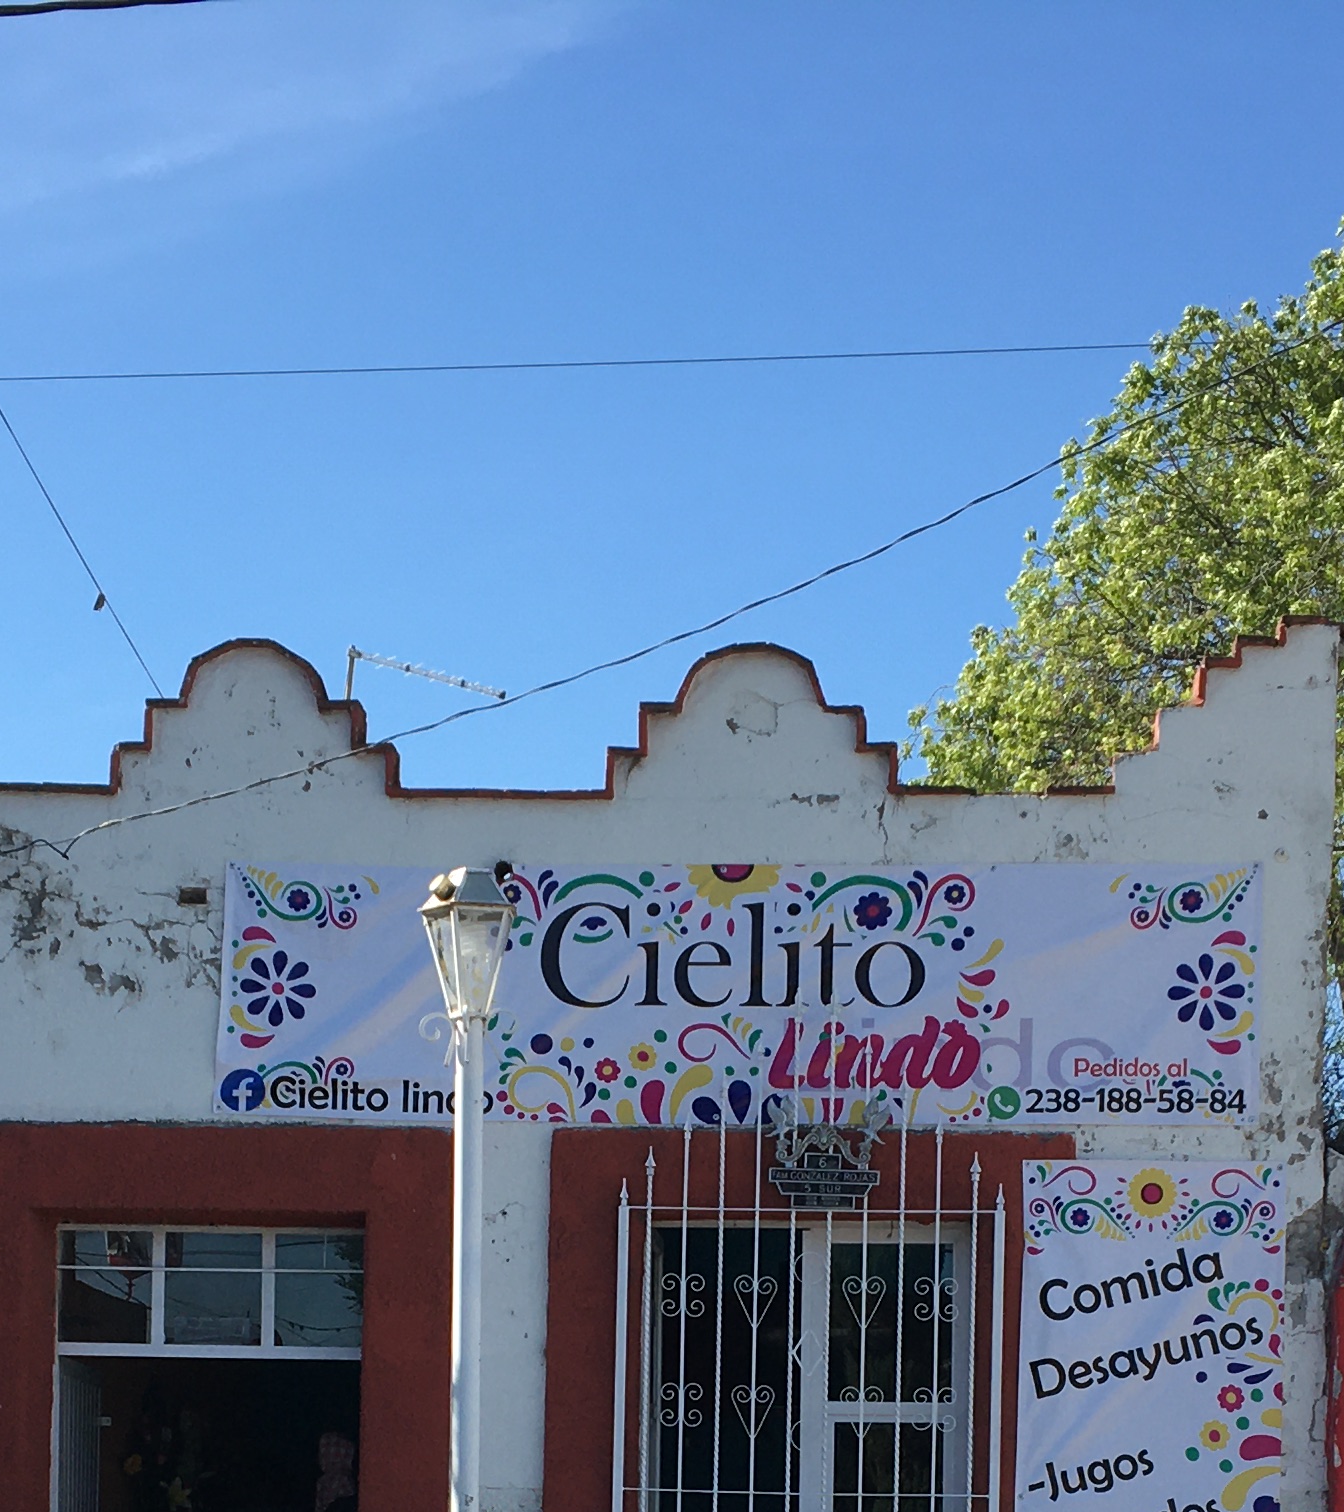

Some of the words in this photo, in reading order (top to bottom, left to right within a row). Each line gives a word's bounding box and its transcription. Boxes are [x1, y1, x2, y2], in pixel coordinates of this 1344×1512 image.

[540, 902, 926, 1008] Cielito
[768, 1015, 981, 1090] Lindo
[1073, 1057, 1160, 1078] Pedidos
[1167, 1057, 1188, 1078] al
[270, 1075, 389, 1112] Cielito
[1025, 1087, 1247, 1115] 238-188-58-84
[818, 1157, 827, 1168] 6
[843, 1172, 875, 1182] ROJAS
[818, 1185, 841, 1193] SUR
[1039, 1248, 1224, 1320] Comida
[1029, 1317, 1263, 1399] Desayunos
[1028, 1449, 1155, 1502] -Jugos
